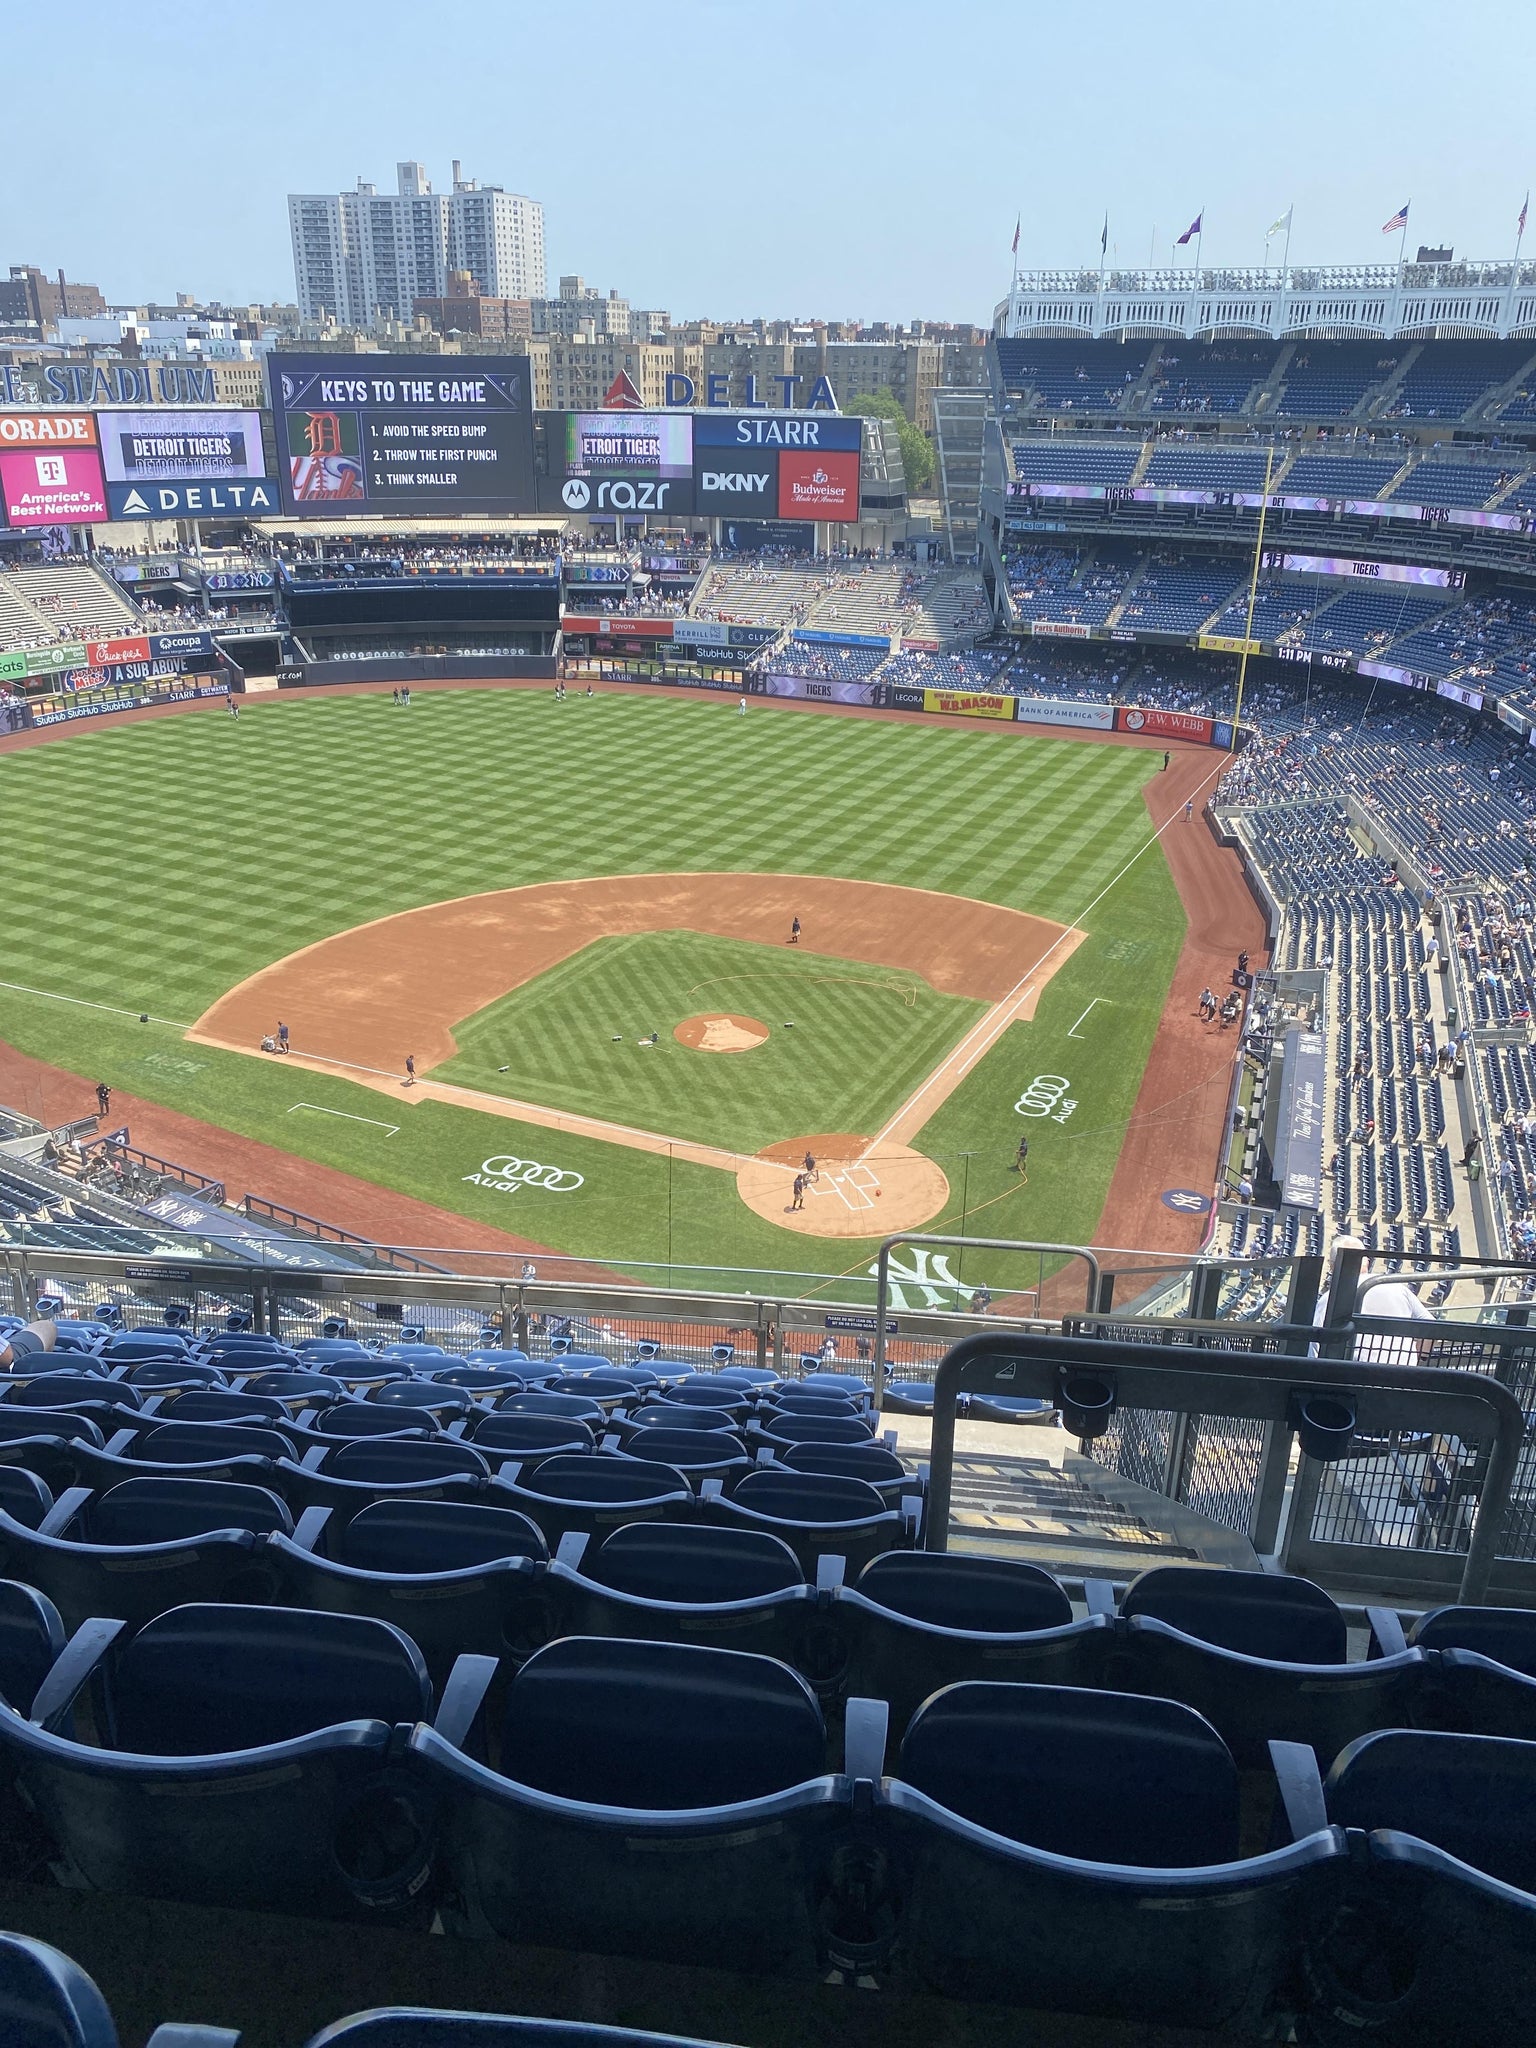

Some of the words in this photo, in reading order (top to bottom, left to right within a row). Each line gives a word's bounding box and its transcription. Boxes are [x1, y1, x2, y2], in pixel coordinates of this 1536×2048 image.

[44, 365, 217, 403] STADIUM
[321, 380, 367, 402] KEYS
[372, 381, 396, 402] TO
[400, 381, 434, 402] THE
[438, 381, 486, 402] GAME
[665, 373, 838, 410] DELTA
[371, 426, 379, 437] 1.
[382, 426, 409, 437] AVOID
[411, 426, 429, 437] THE
[431, 426, 460, 437] SPEED
[462, 426, 487, 437] BUMP
[736, 419, 819, 445] STARR
[133, 438, 185, 457] DETROIT
[187, 437, 232, 456] TIGERS
[624, 438, 660, 456] TIGERS
[373, 450, 382, 461] 2.
[385, 450, 417, 461] THROW
[419, 450, 437, 461] THE
[439, 450, 465, 461] FIRST
[467, 450, 497, 461] PUNCH
[136, 458, 187, 476] DETROIT
[189, 457, 233, 475] TIGERS
[375, 474, 383, 485] 3.
[386, 474, 415, 485] THINK
[416, 474, 457, 485] SMALLER
[702, 472, 769, 492] DKNY
[597, 481, 670, 510] razr
[792, 482, 846, 496] Budweiser
[1105, 487, 1136, 500] TIGERS
[20, 490, 91, 504] America's
[158, 486, 271, 510] DELTA
[1272, 496, 1286, 507] DET
[10, 504, 42, 516] Best
[44, 501, 104, 515] Network
[1421, 506, 1450, 522] TIGERS
[675, 559, 700, 570] TIGERS
[1352, 562, 1380, 576] TIGERS
[142, 566, 170, 578] TIGERS
[675, 630, 708, 638] MERRILL
[172, 637, 201, 647] coupa
[696, 647, 734, 660] StubHub
[1278, 647, 1294, 660] 1:11
[1296, 650, 1312, 663] PM
[1322, 655, 1347, 668] 90.9°F
[116, 665, 124, 681] A
[126, 662, 149, 680] SUB
[152, 657, 188, 676] ABOVE
[607, 672, 632, 681] STARR
[170, 690, 195, 701] STARR
[200, 684, 228, 694] CUTWATER
[806, 682, 832, 697] TIGERS
[895, 693, 923, 703] LEGORA
[67, 706, 99, 719] StubHub
[101, 701, 134, 713] StubHub
[1020, 706, 1042, 715] BANK
[1044, 708, 1054, 716] OF
[1055, 710, 1093, 720] AMERICA
[36, 713, 66, 726] StubHub
[1146, 712, 1168, 726] F.W.
[1171, 715, 1204, 732] WEBB
[1297, 1081, 1322, 1109] Yankees
[1051, 1098, 1079, 1124] Audi
[461, 1172, 522, 1193] Audi
[286, 1255, 302, 1265] to
